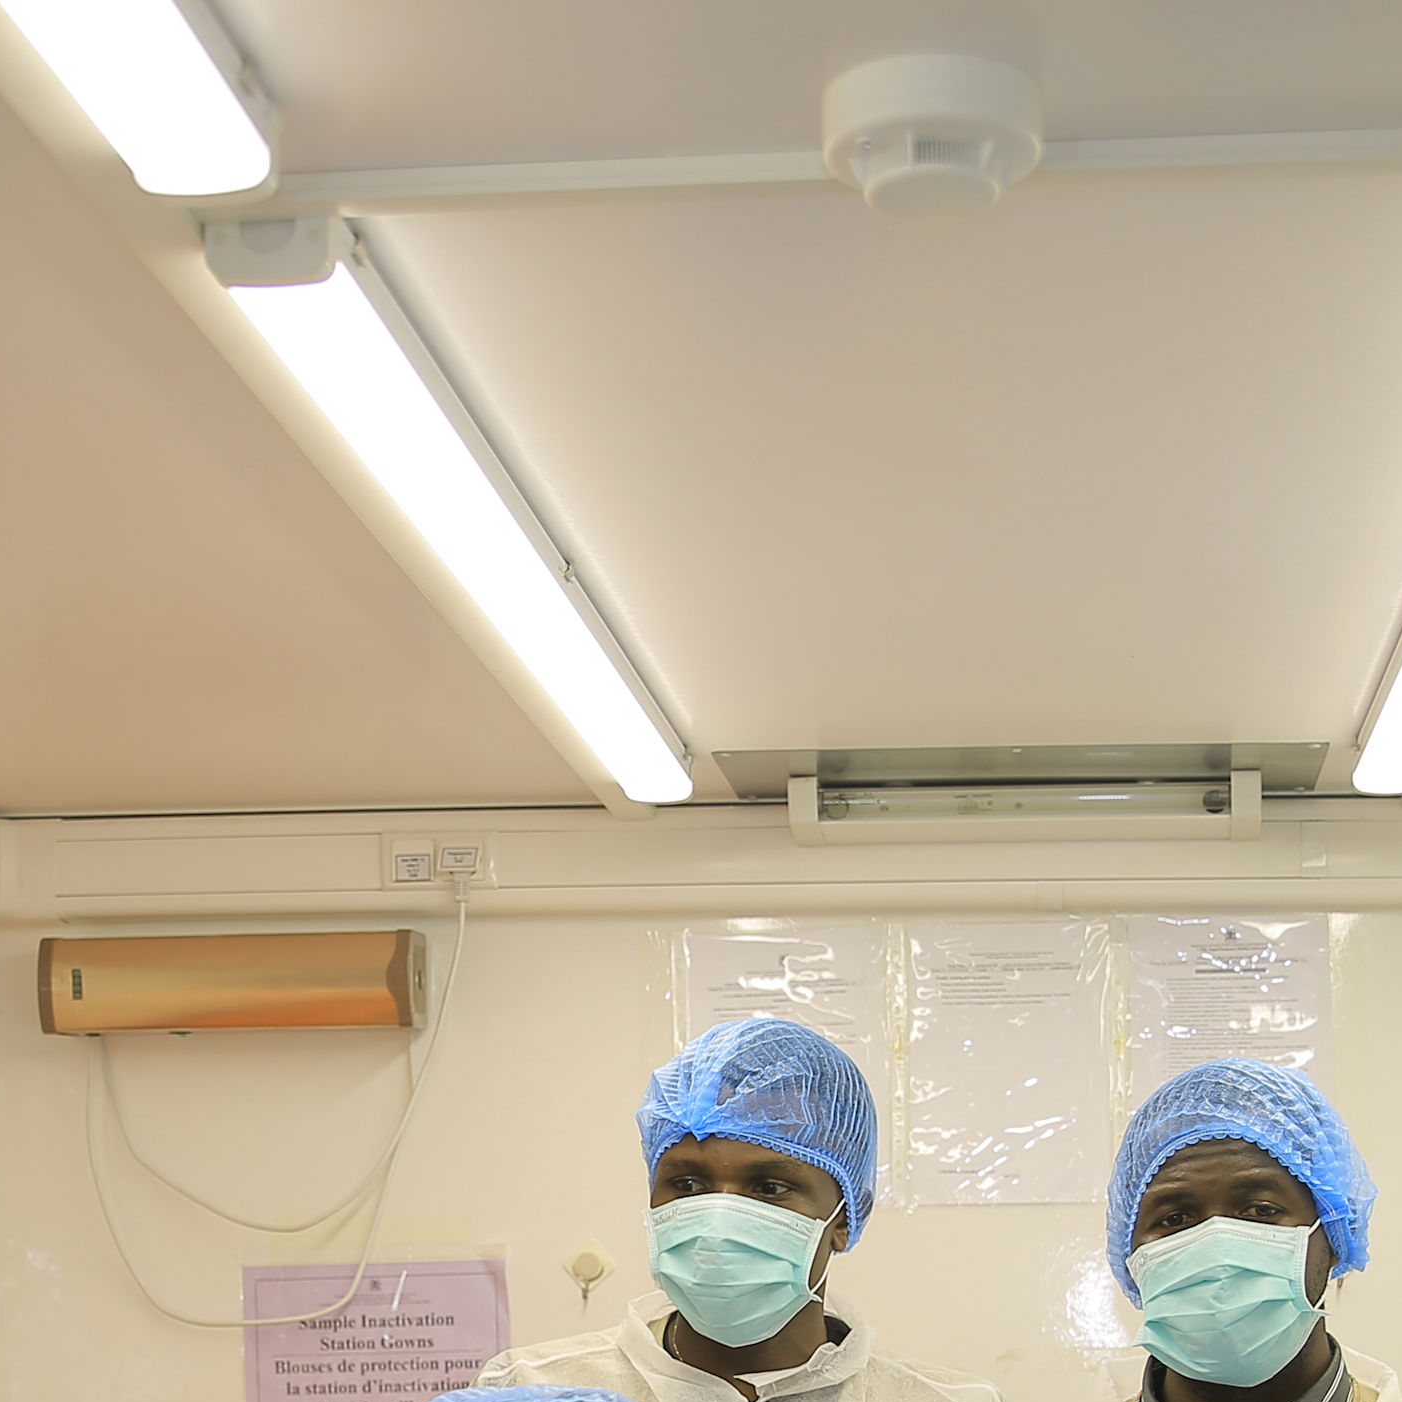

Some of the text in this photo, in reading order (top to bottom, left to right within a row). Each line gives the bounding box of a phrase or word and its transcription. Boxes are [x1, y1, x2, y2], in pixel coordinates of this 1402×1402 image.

[298, 1313, 455, 1333] Sample Inactivation
[320, 1335, 434, 1352] Station Gowns
[275, 1357, 482, 1376] Blouses de protection pour
[286, 1380, 301, 1396] la
[305, 1380, 358, 1396] station
